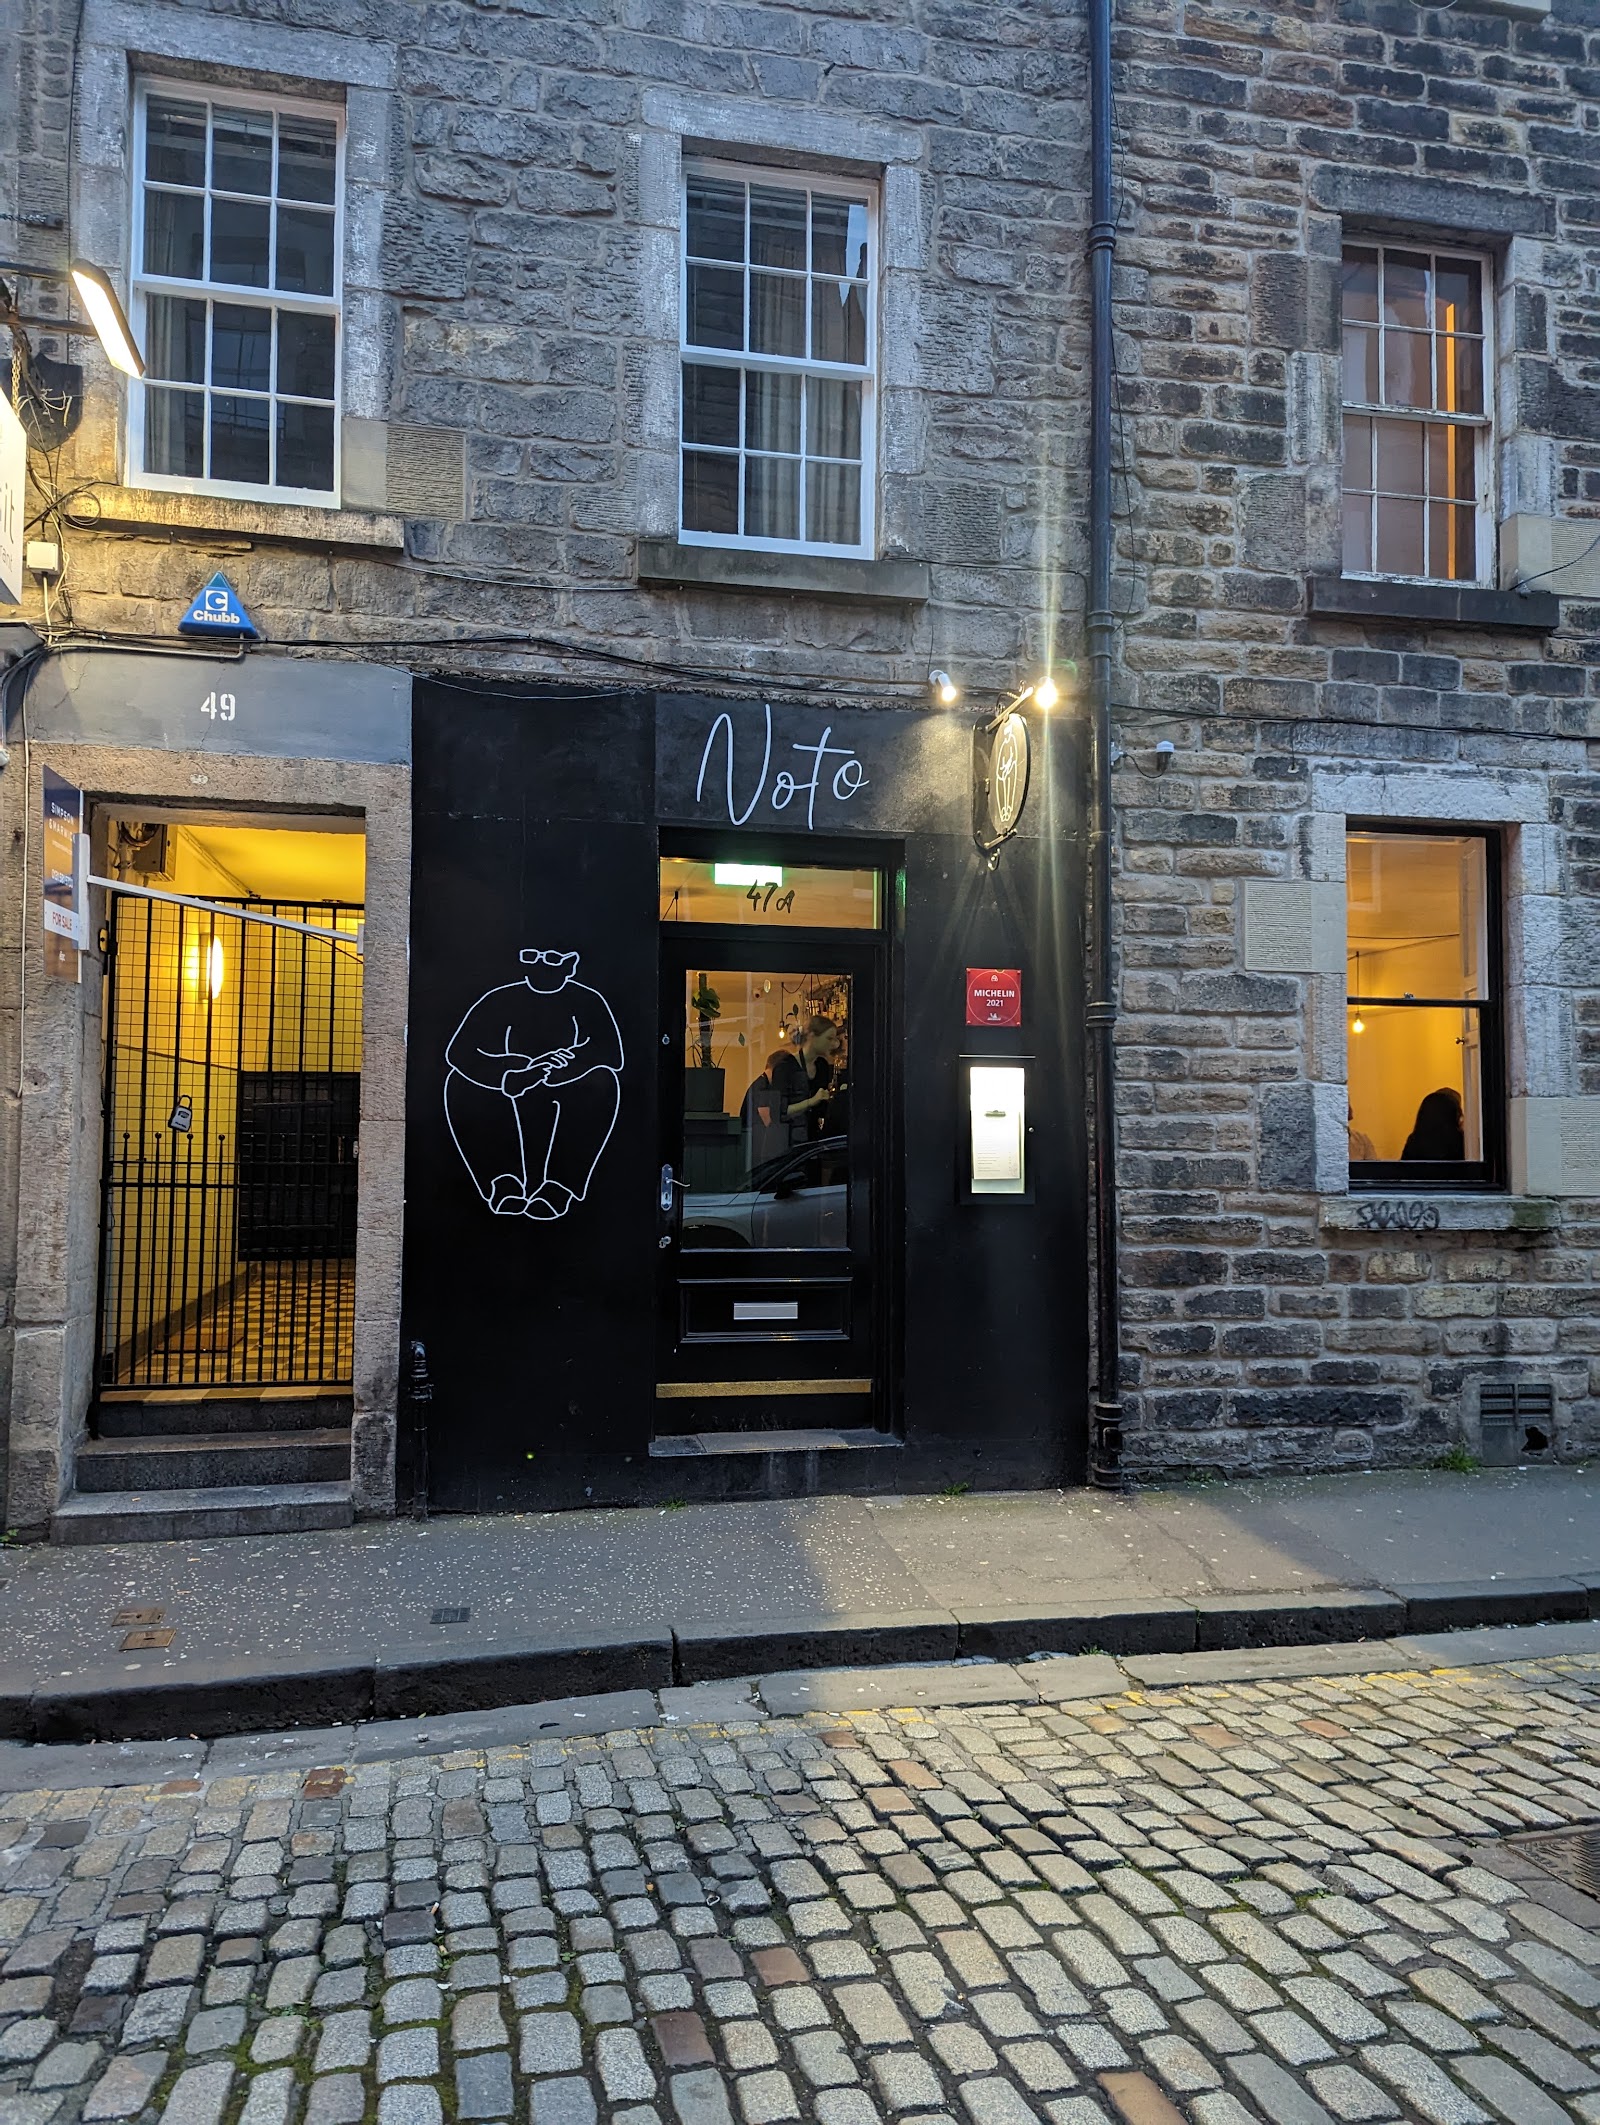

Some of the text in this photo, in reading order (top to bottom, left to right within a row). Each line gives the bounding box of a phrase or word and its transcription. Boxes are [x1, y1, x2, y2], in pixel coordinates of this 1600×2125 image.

[192, 609, 240, 624] Chubb
[200, 691, 236, 721] 49
[696, 703, 870, 831] Noto
[51, 802, 74, 825] SIMPSON
[52, 911, 73, 931] FOR SALE
[974, 989, 1015, 998] MICHELIN
[986, 999, 1004, 1007] 2021
